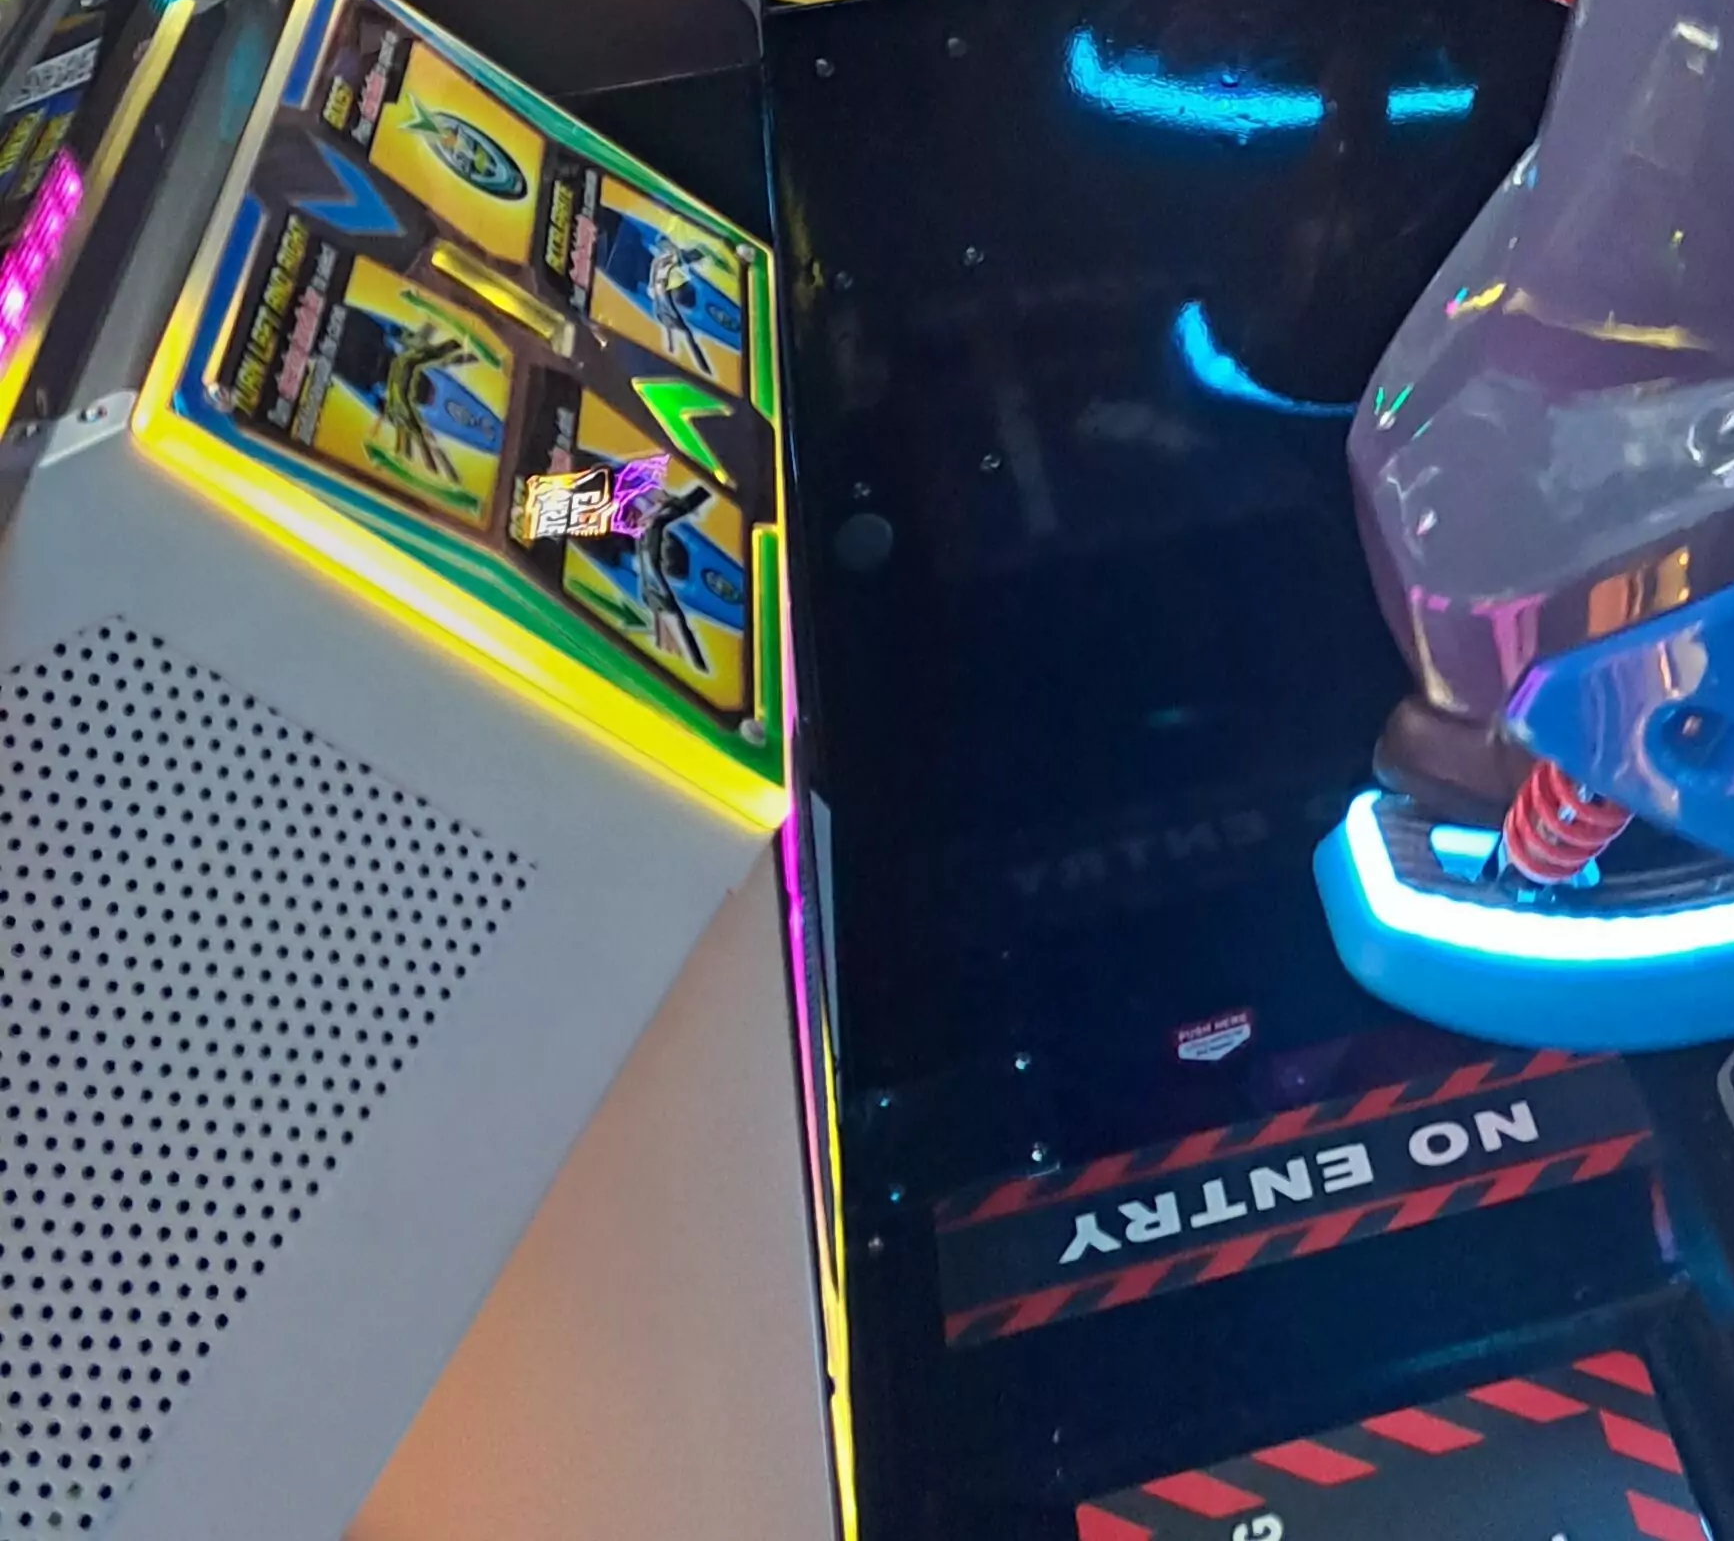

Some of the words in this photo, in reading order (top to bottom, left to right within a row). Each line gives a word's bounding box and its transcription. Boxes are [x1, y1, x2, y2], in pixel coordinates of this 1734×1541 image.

[276, 216, 308, 272] RIGHT
[264, 267, 293, 309] AND
[250, 306, 279, 363] LEFT
[232, 359, 266, 413] TURN
[1407, 1102, 1541, 1167] NO
[1059, 1144, 1374, 1263] ENTRY
